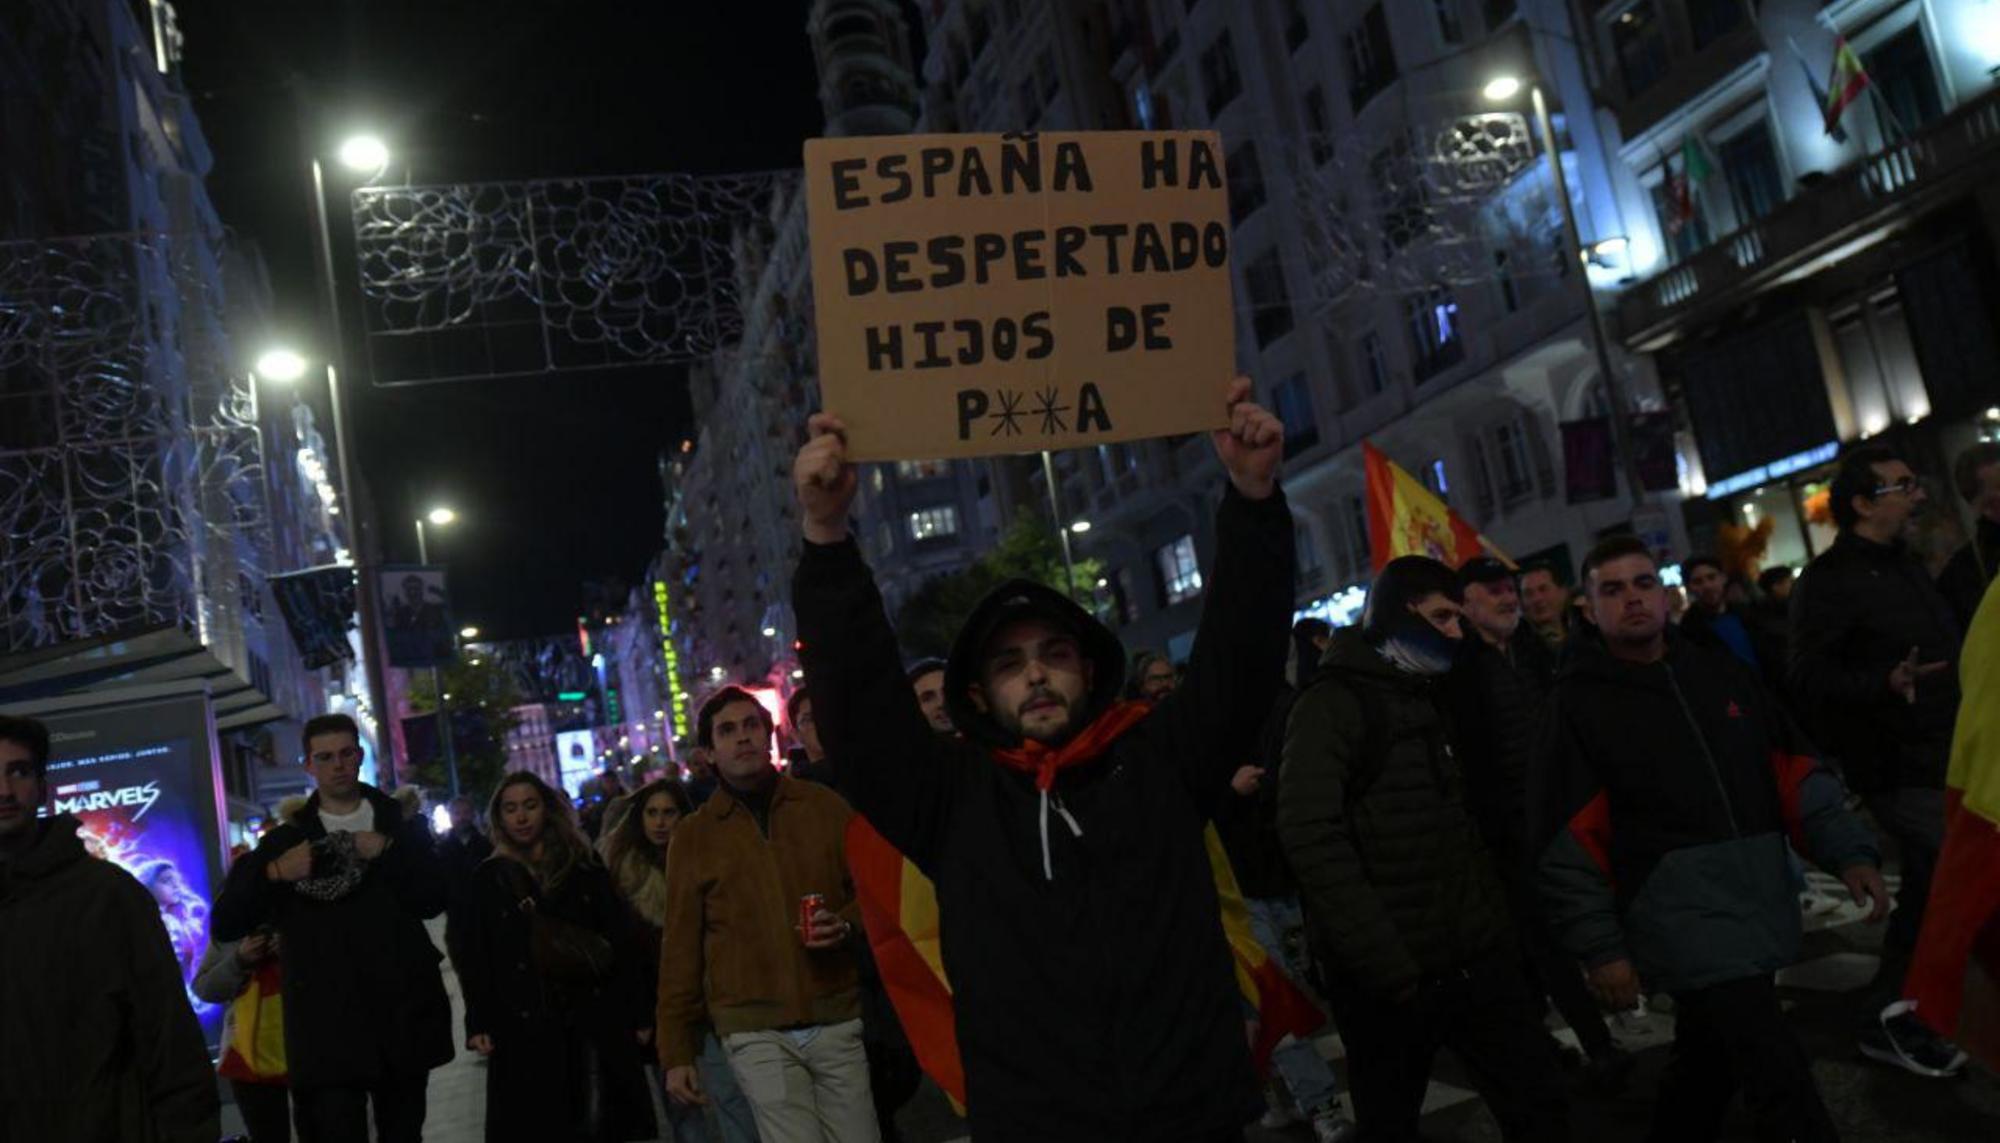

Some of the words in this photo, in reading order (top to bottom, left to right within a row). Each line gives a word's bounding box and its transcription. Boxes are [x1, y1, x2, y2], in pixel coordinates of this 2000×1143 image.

[831, 132, 1093, 210] ESPAÑA
[1141, 139, 1222, 190] HA
[842, 221, 1227, 297] DESPERTADO
[865, 311, 1054, 371] HIJOS
[1106, 303, 1173, 352] DE
[53, 780, 161, 823] MARVELS
